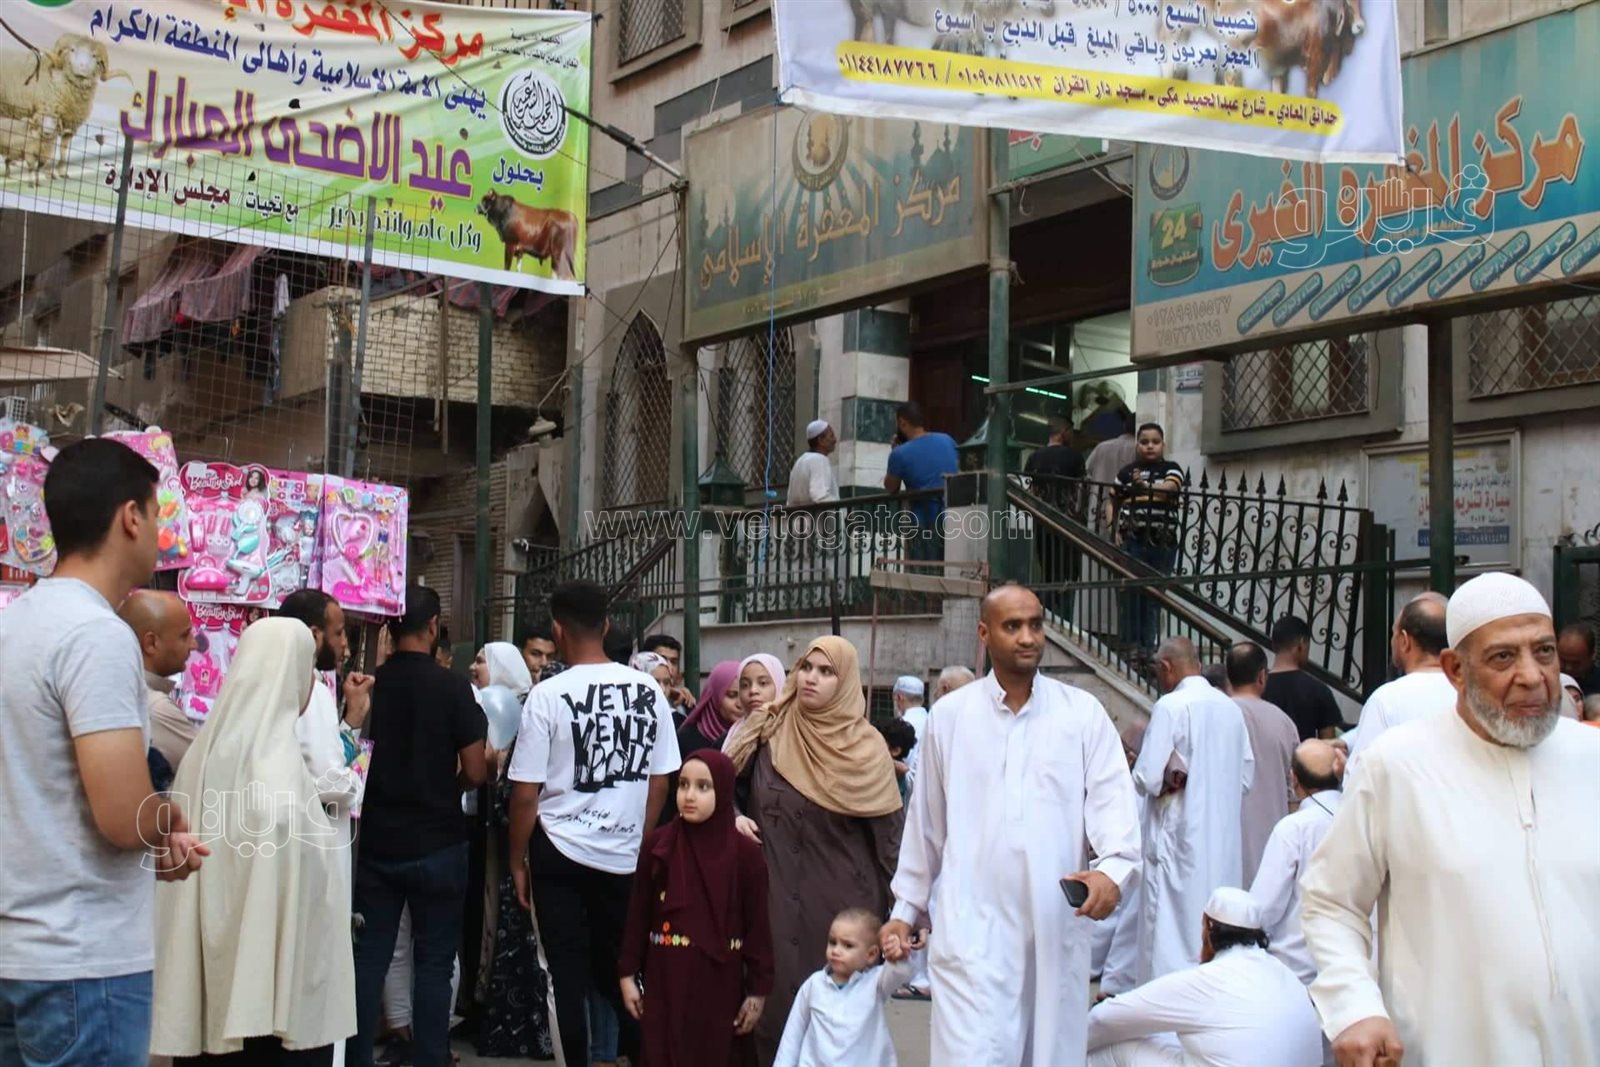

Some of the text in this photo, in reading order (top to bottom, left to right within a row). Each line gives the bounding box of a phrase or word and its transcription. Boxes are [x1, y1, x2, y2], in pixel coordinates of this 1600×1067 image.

[90, 6, 161, 42] الكرام
[164, 14, 239, 63] المنطقة
[400, 9, 484, 66] مركز
[1002, 17, 1043, 47] الذبح
[1048, 22, 1077, 52] قبل
[1124, 32, 1165, 65] وباقي
[1171, 42, 1219, 71] بعربون
[1222, 45, 1259, 73] الحجز
[1095, 83, 1112, 99] دار
[119, 69, 257, 171] المبارك
[408, 137, 473, 212] عيد
[492, 157, 544, 191] بحلول
[1477, 95, 1584, 221] مركز
[173, 178, 231, 210] مجلس
[891, 167, 962, 238] مركز
[796, 174, 881, 263] المغفرة
[1161, 212, 1187, 249] 24
